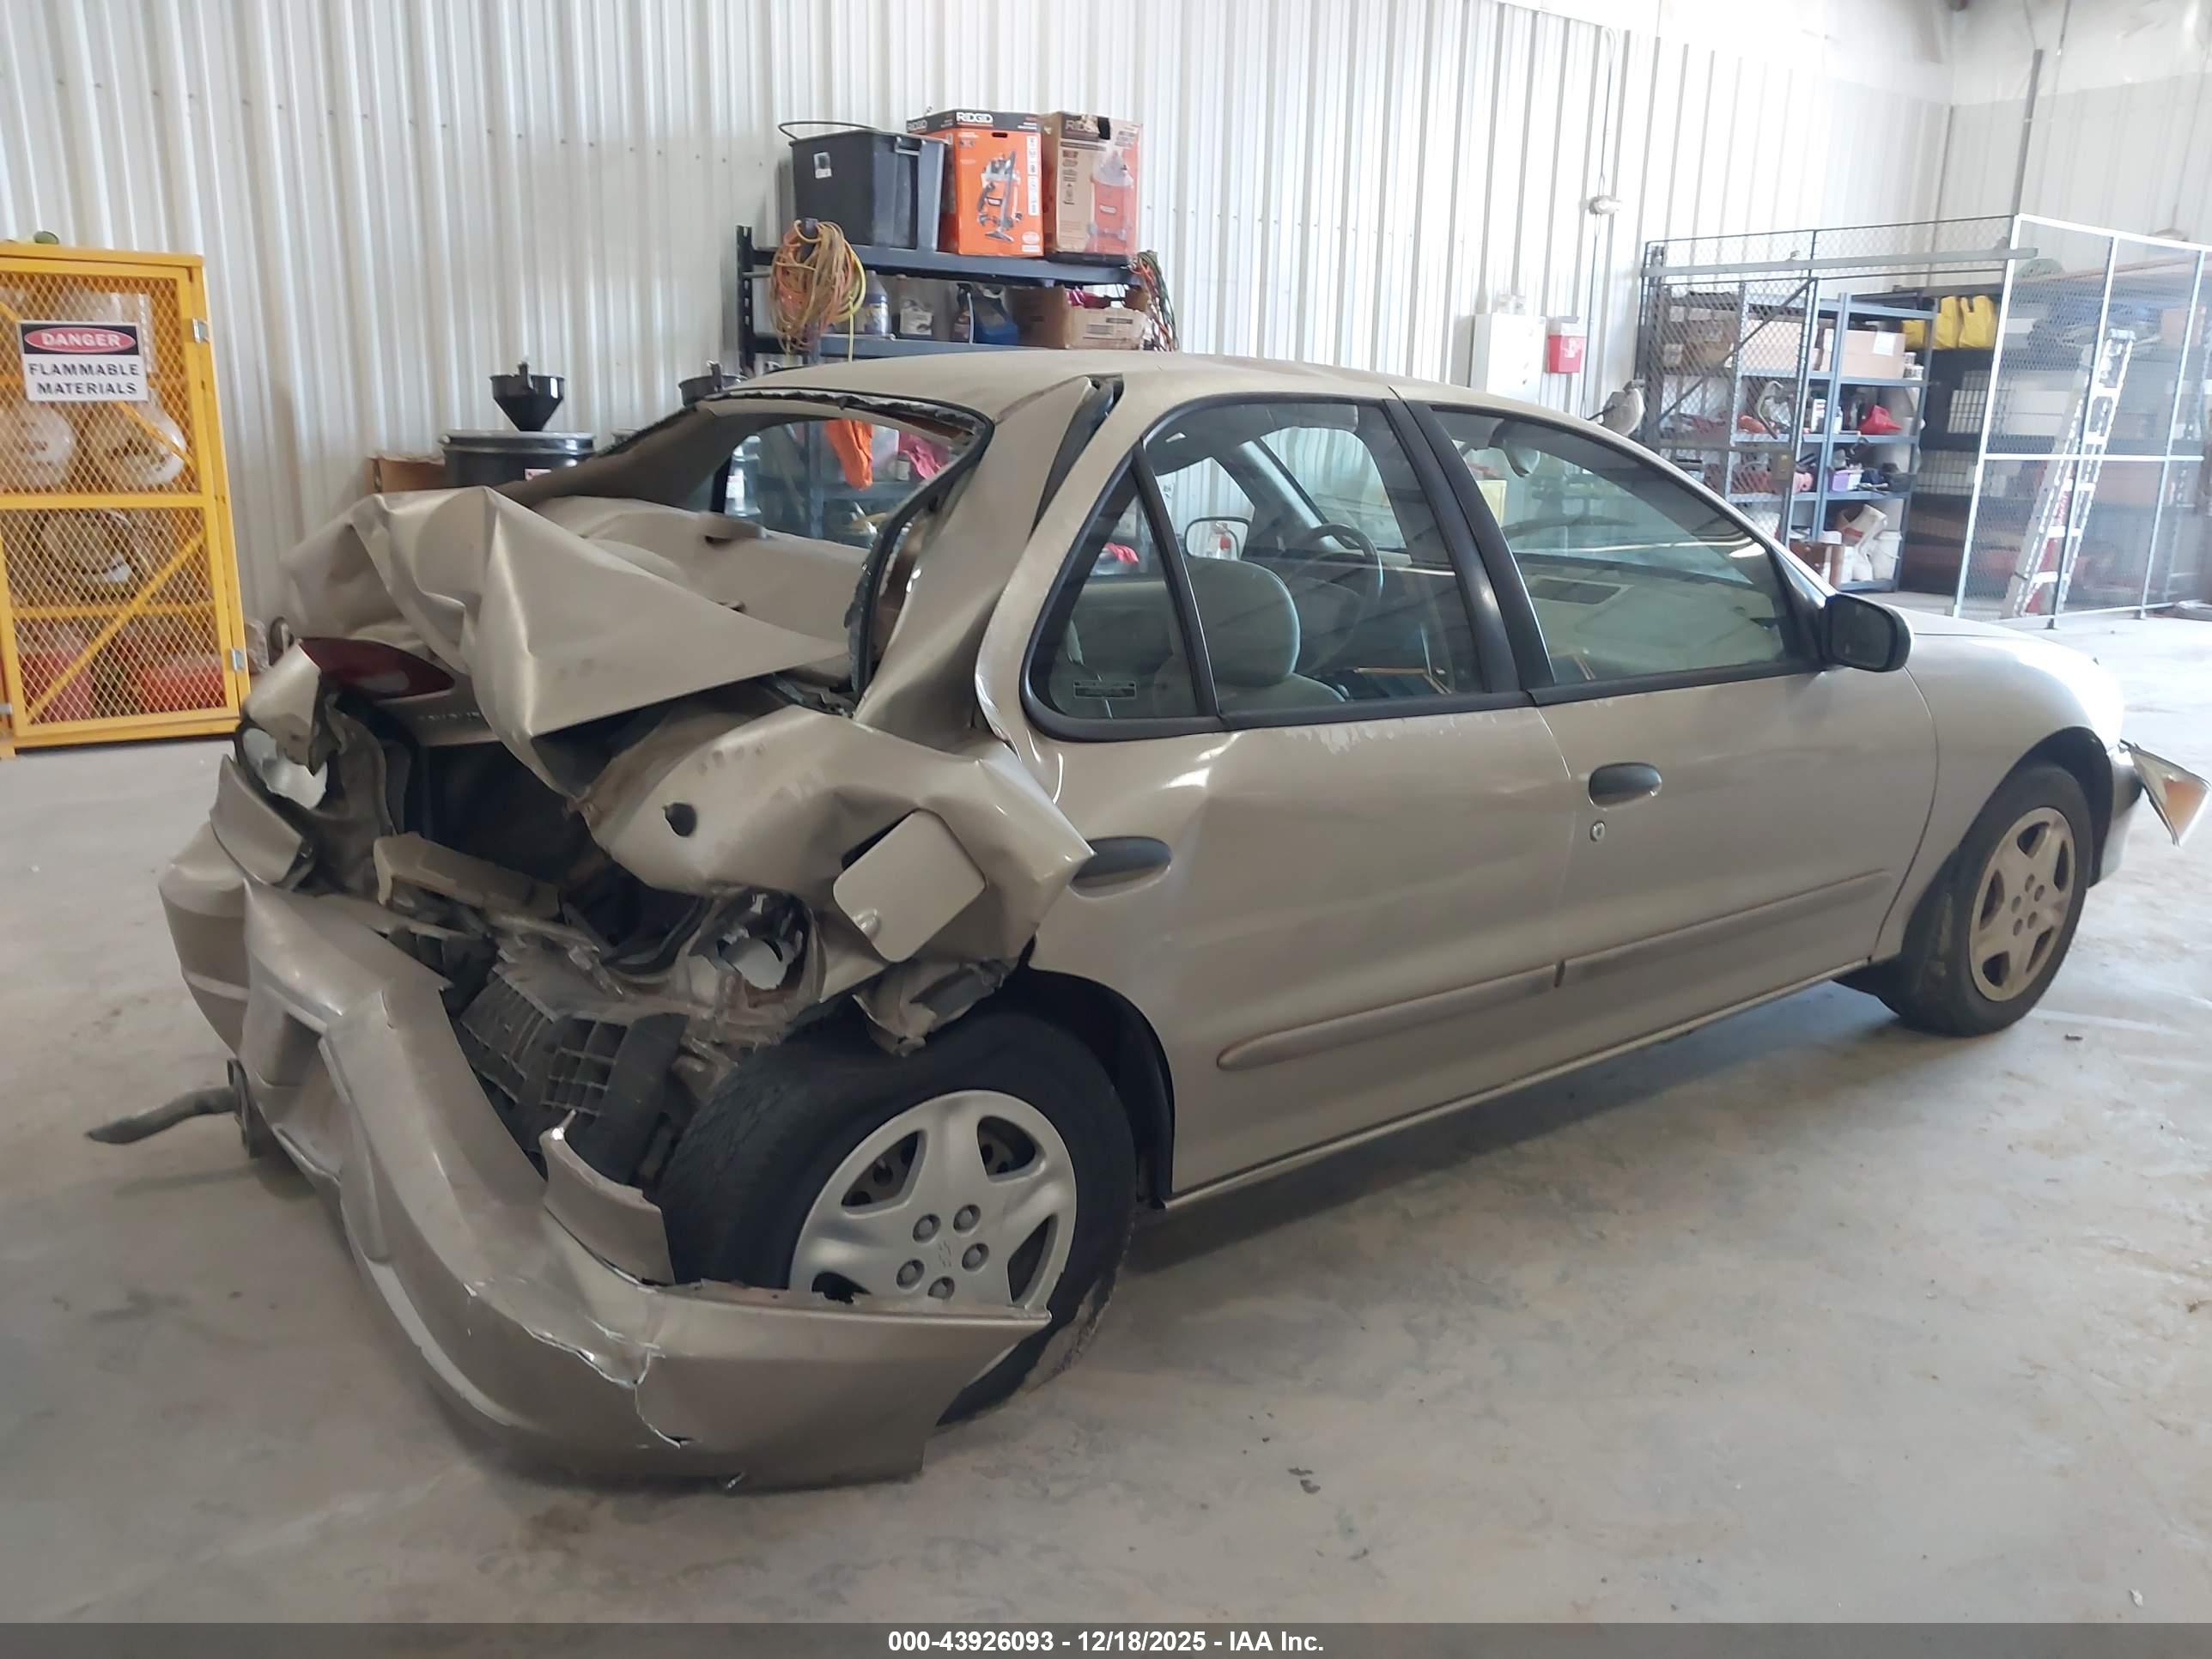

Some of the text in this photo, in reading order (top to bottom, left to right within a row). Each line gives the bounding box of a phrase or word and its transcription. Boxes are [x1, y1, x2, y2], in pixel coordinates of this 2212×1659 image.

[956, 112, 994, 123] RIDGID
[41, 332, 121, 348] DANGER
[27, 362, 140, 376] FLAMMABLE
[37, 382, 137, 395] MATERIALS
